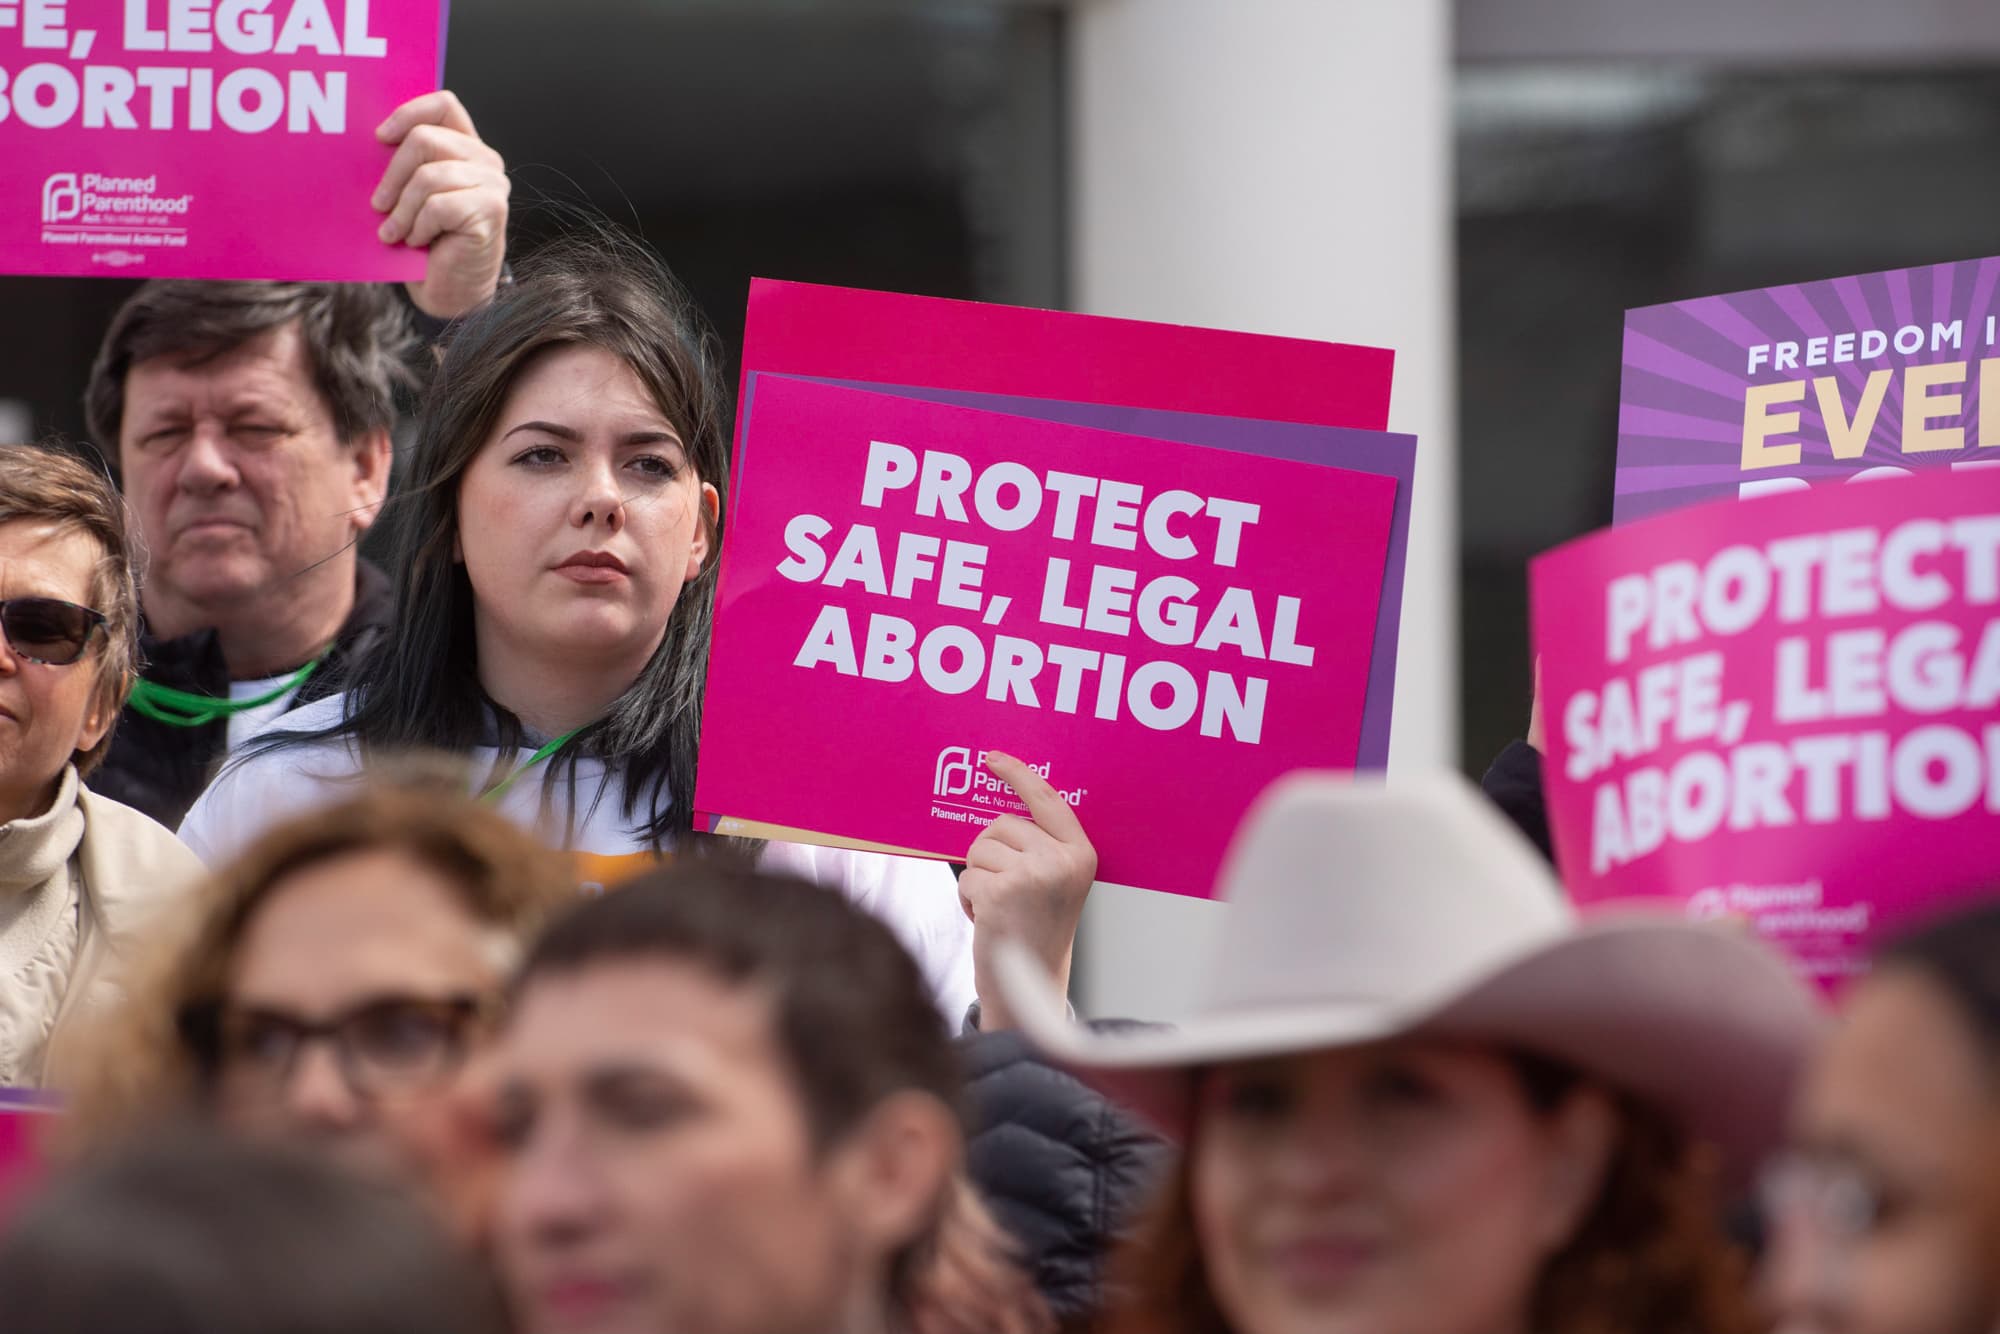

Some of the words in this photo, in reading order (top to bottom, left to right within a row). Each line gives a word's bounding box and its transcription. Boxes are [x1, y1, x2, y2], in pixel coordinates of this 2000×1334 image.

[123, 0, 387, 57] LEGAL
[0, 62, 347, 134] ORTION
[82, 173, 156, 193] Planned
[82, 193, 188, 214] Parenthood
[1747, 319, 1963, 375] FREEDOM
[860, 440, 1261, 568] PROTECT
[775, 514, 1012, 624] SAFE,
[1039, 557, 1315, 667] LEGAL
[1606, 512, 2000, 663] PROTECT
[793, 605, 1268, 745] ABORTION
[1563, 650, 1750, 782] SAFE,
[931, 806, 966, 822] Planned
[971, 793, 991, 805] Act.
[993, 797, 1005, 807] No
[1591, 723, 2000, 876] ABORTIO
